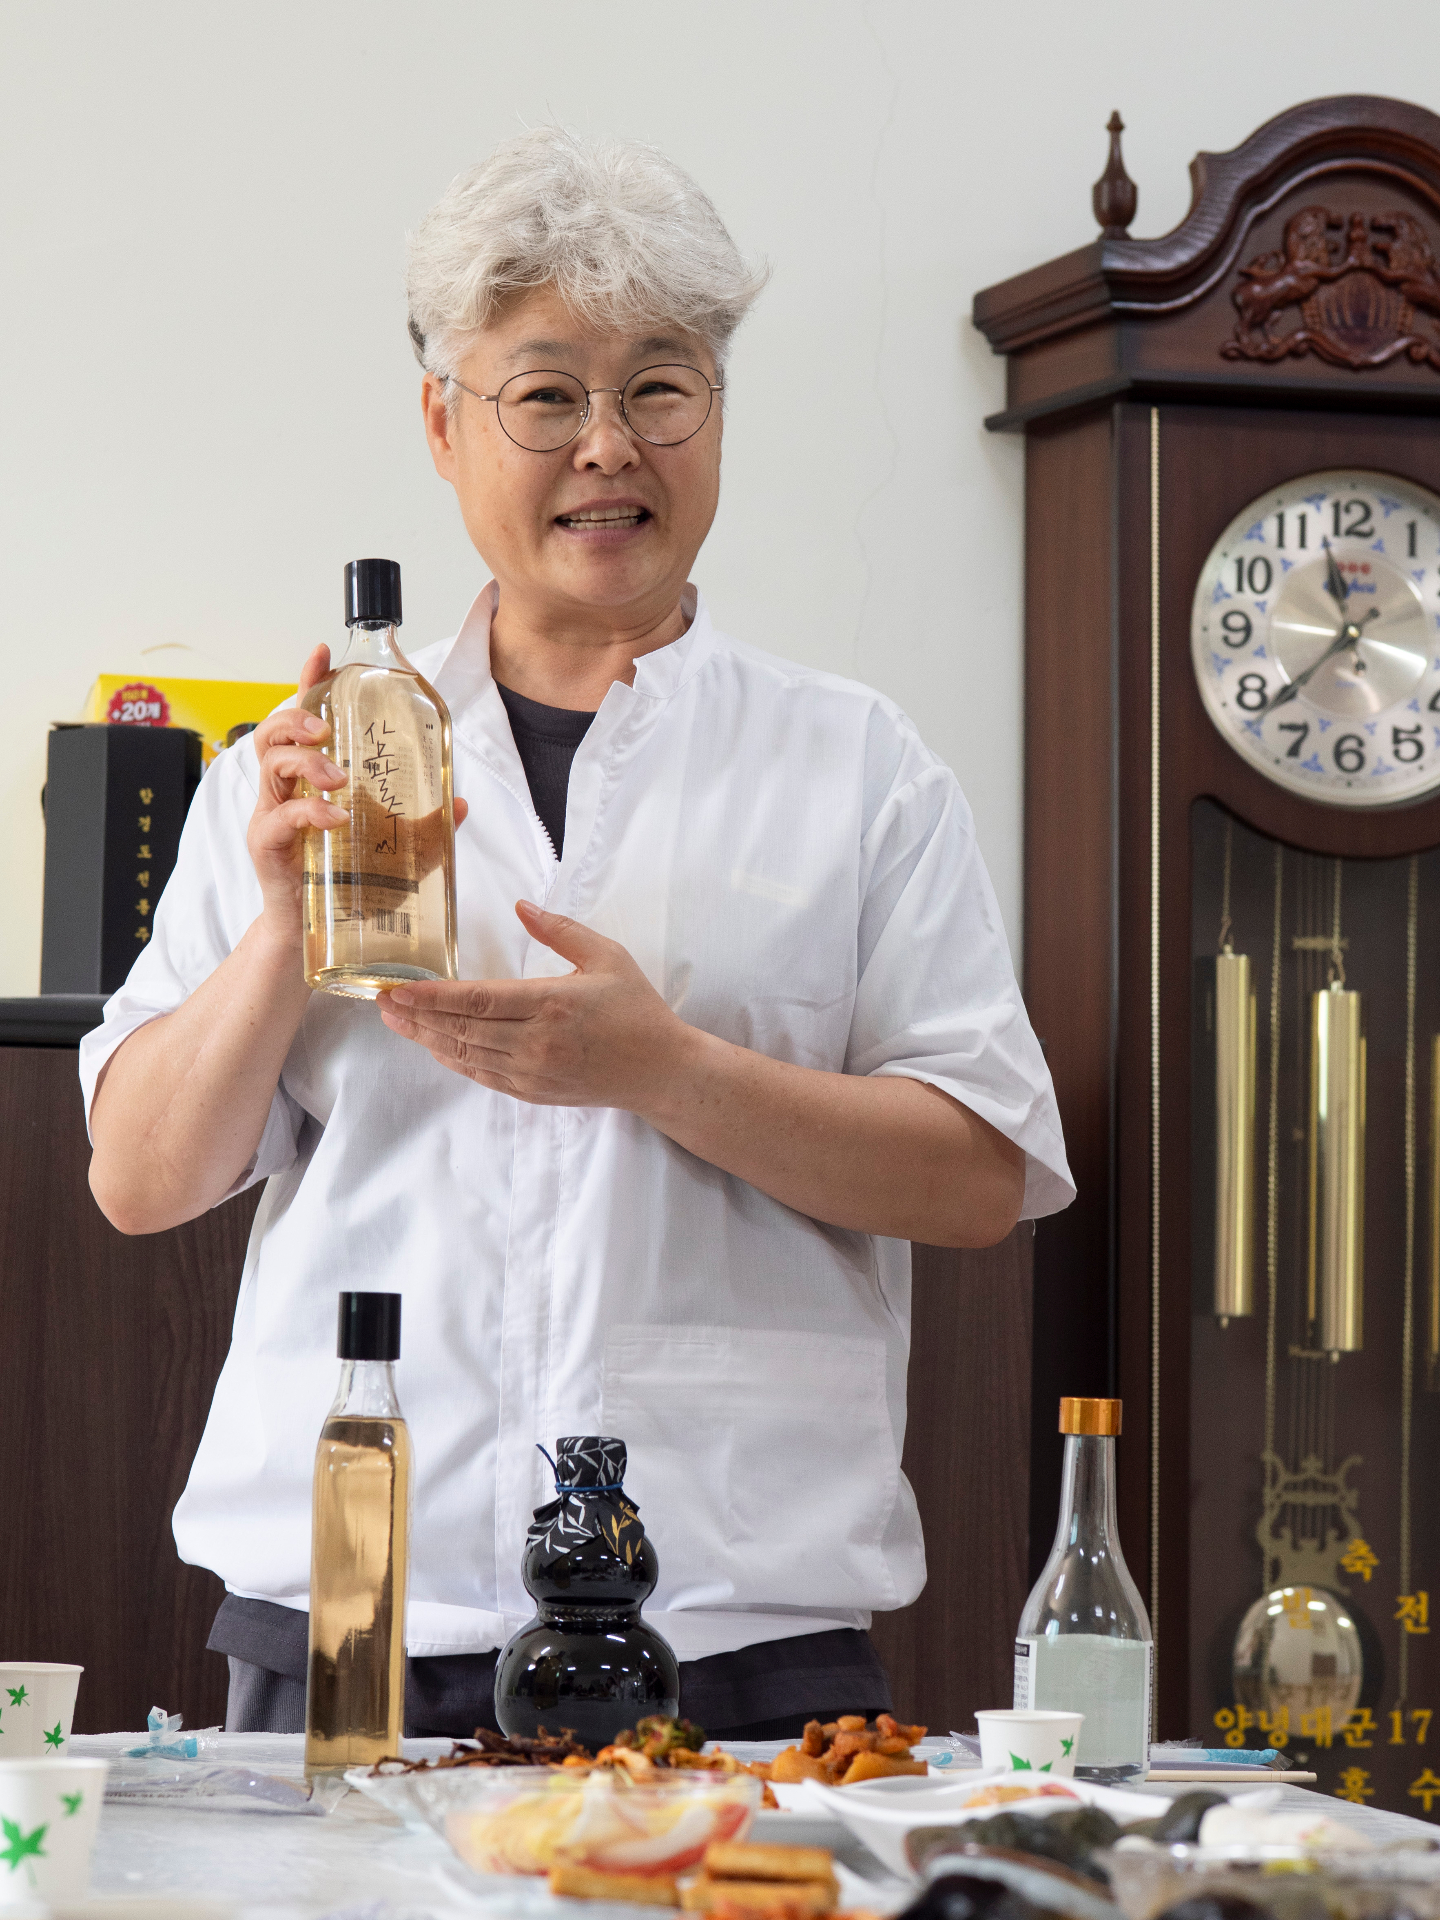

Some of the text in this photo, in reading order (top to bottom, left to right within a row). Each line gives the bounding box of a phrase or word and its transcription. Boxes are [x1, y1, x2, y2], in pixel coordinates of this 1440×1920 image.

[1276, 511, 1307, 549] 11
[1332, 498, 1375, 538] 12
[1406, 519, 1418, 558] 1
[1234, 556, 1273, 594] 10
[1220, 610, 1253, 648] 9
[1236, 672, 1269, 711] 8
[1277, 722, 1309, 758] 7
[1333, 734, 1366, 773] 6
[1391, 723, 1425, 763] 5
[1340, 1538, 1379, 1582] 축
